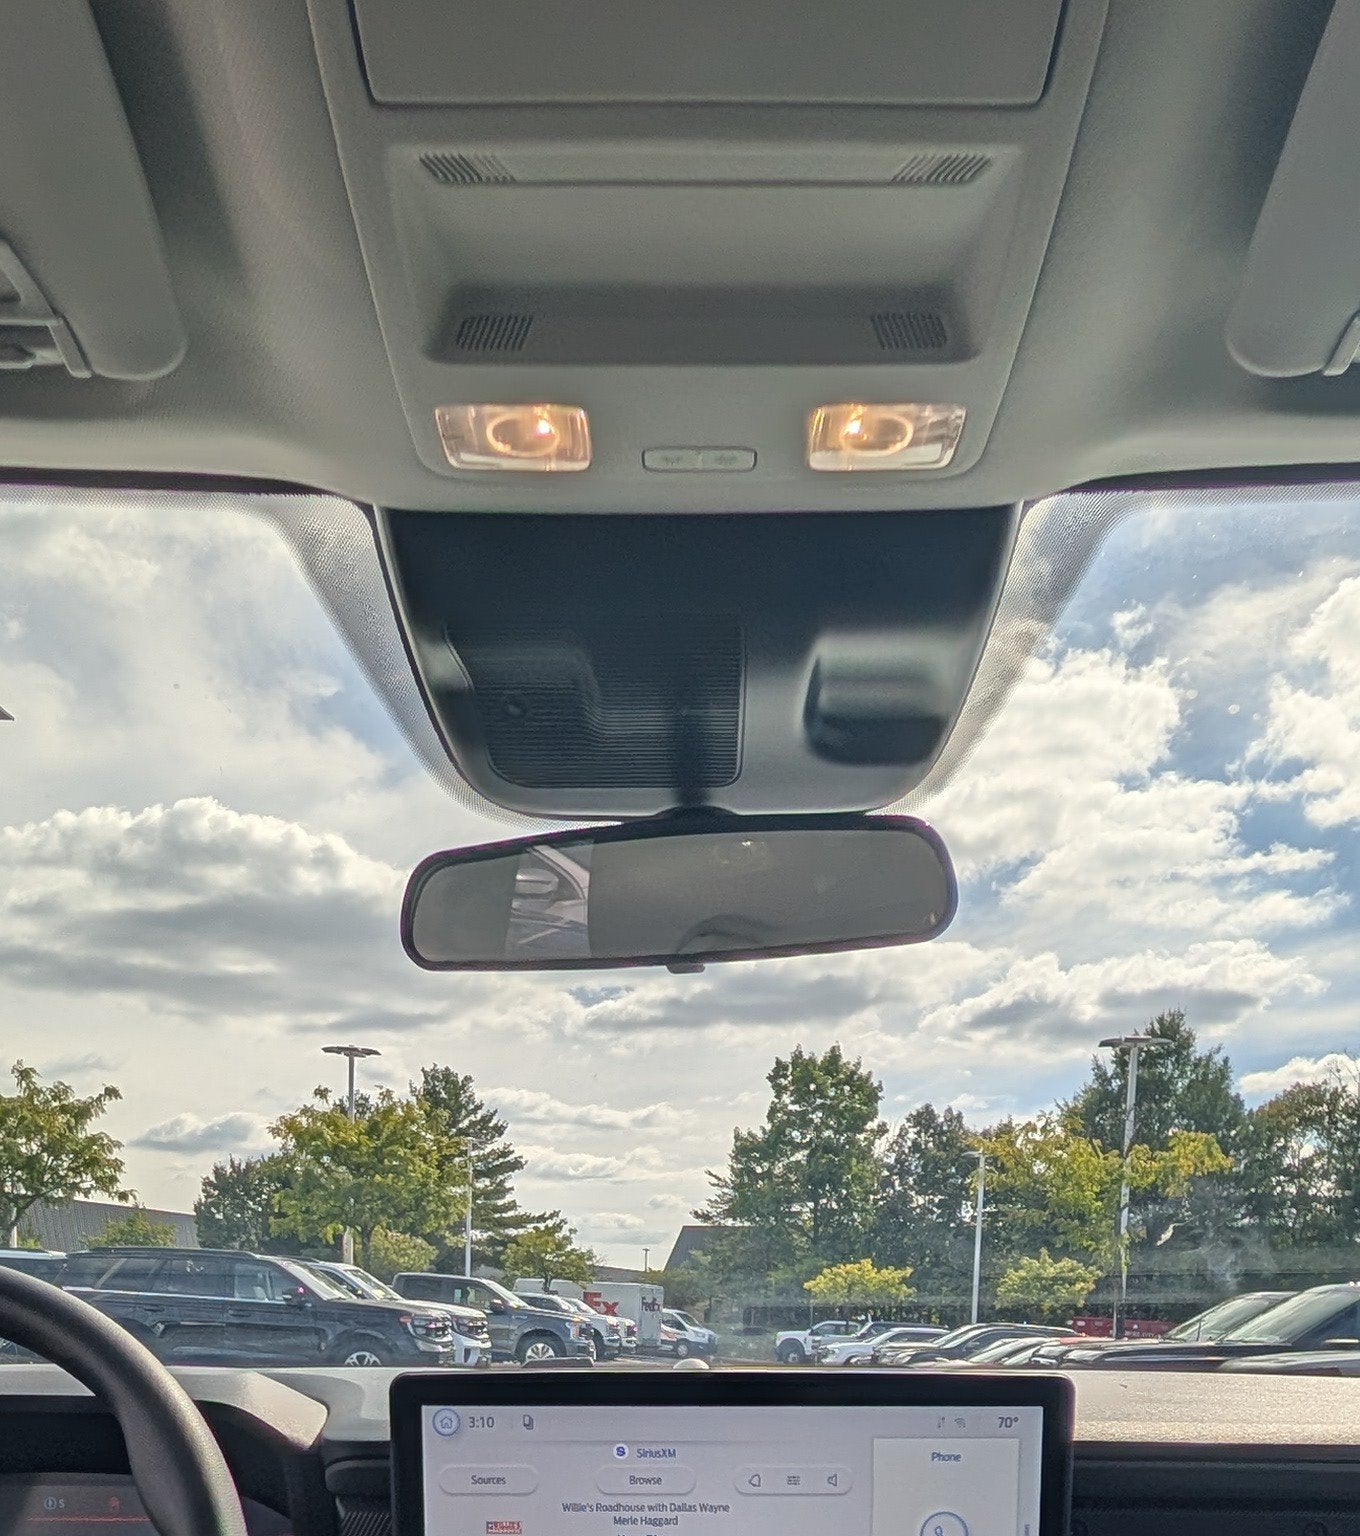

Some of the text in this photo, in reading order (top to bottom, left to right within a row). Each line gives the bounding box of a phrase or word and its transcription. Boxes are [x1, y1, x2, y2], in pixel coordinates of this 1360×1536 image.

[468, 1416, 495, 1428] 3:10
[998, 1416, 1019, 1428] 70°
[637, 1447, 676, 1459] SiriusXM
[931, 1452, 961, 1463] Phone
[471, 1474, 507, 1486] Sources
[629, 1474, 662, 1486] Browse
[562, 1502, 730, 1514] Willie's Roadhouse with Dallas Wayne
[613, 1515, 678, 1528] Merle Haggard
